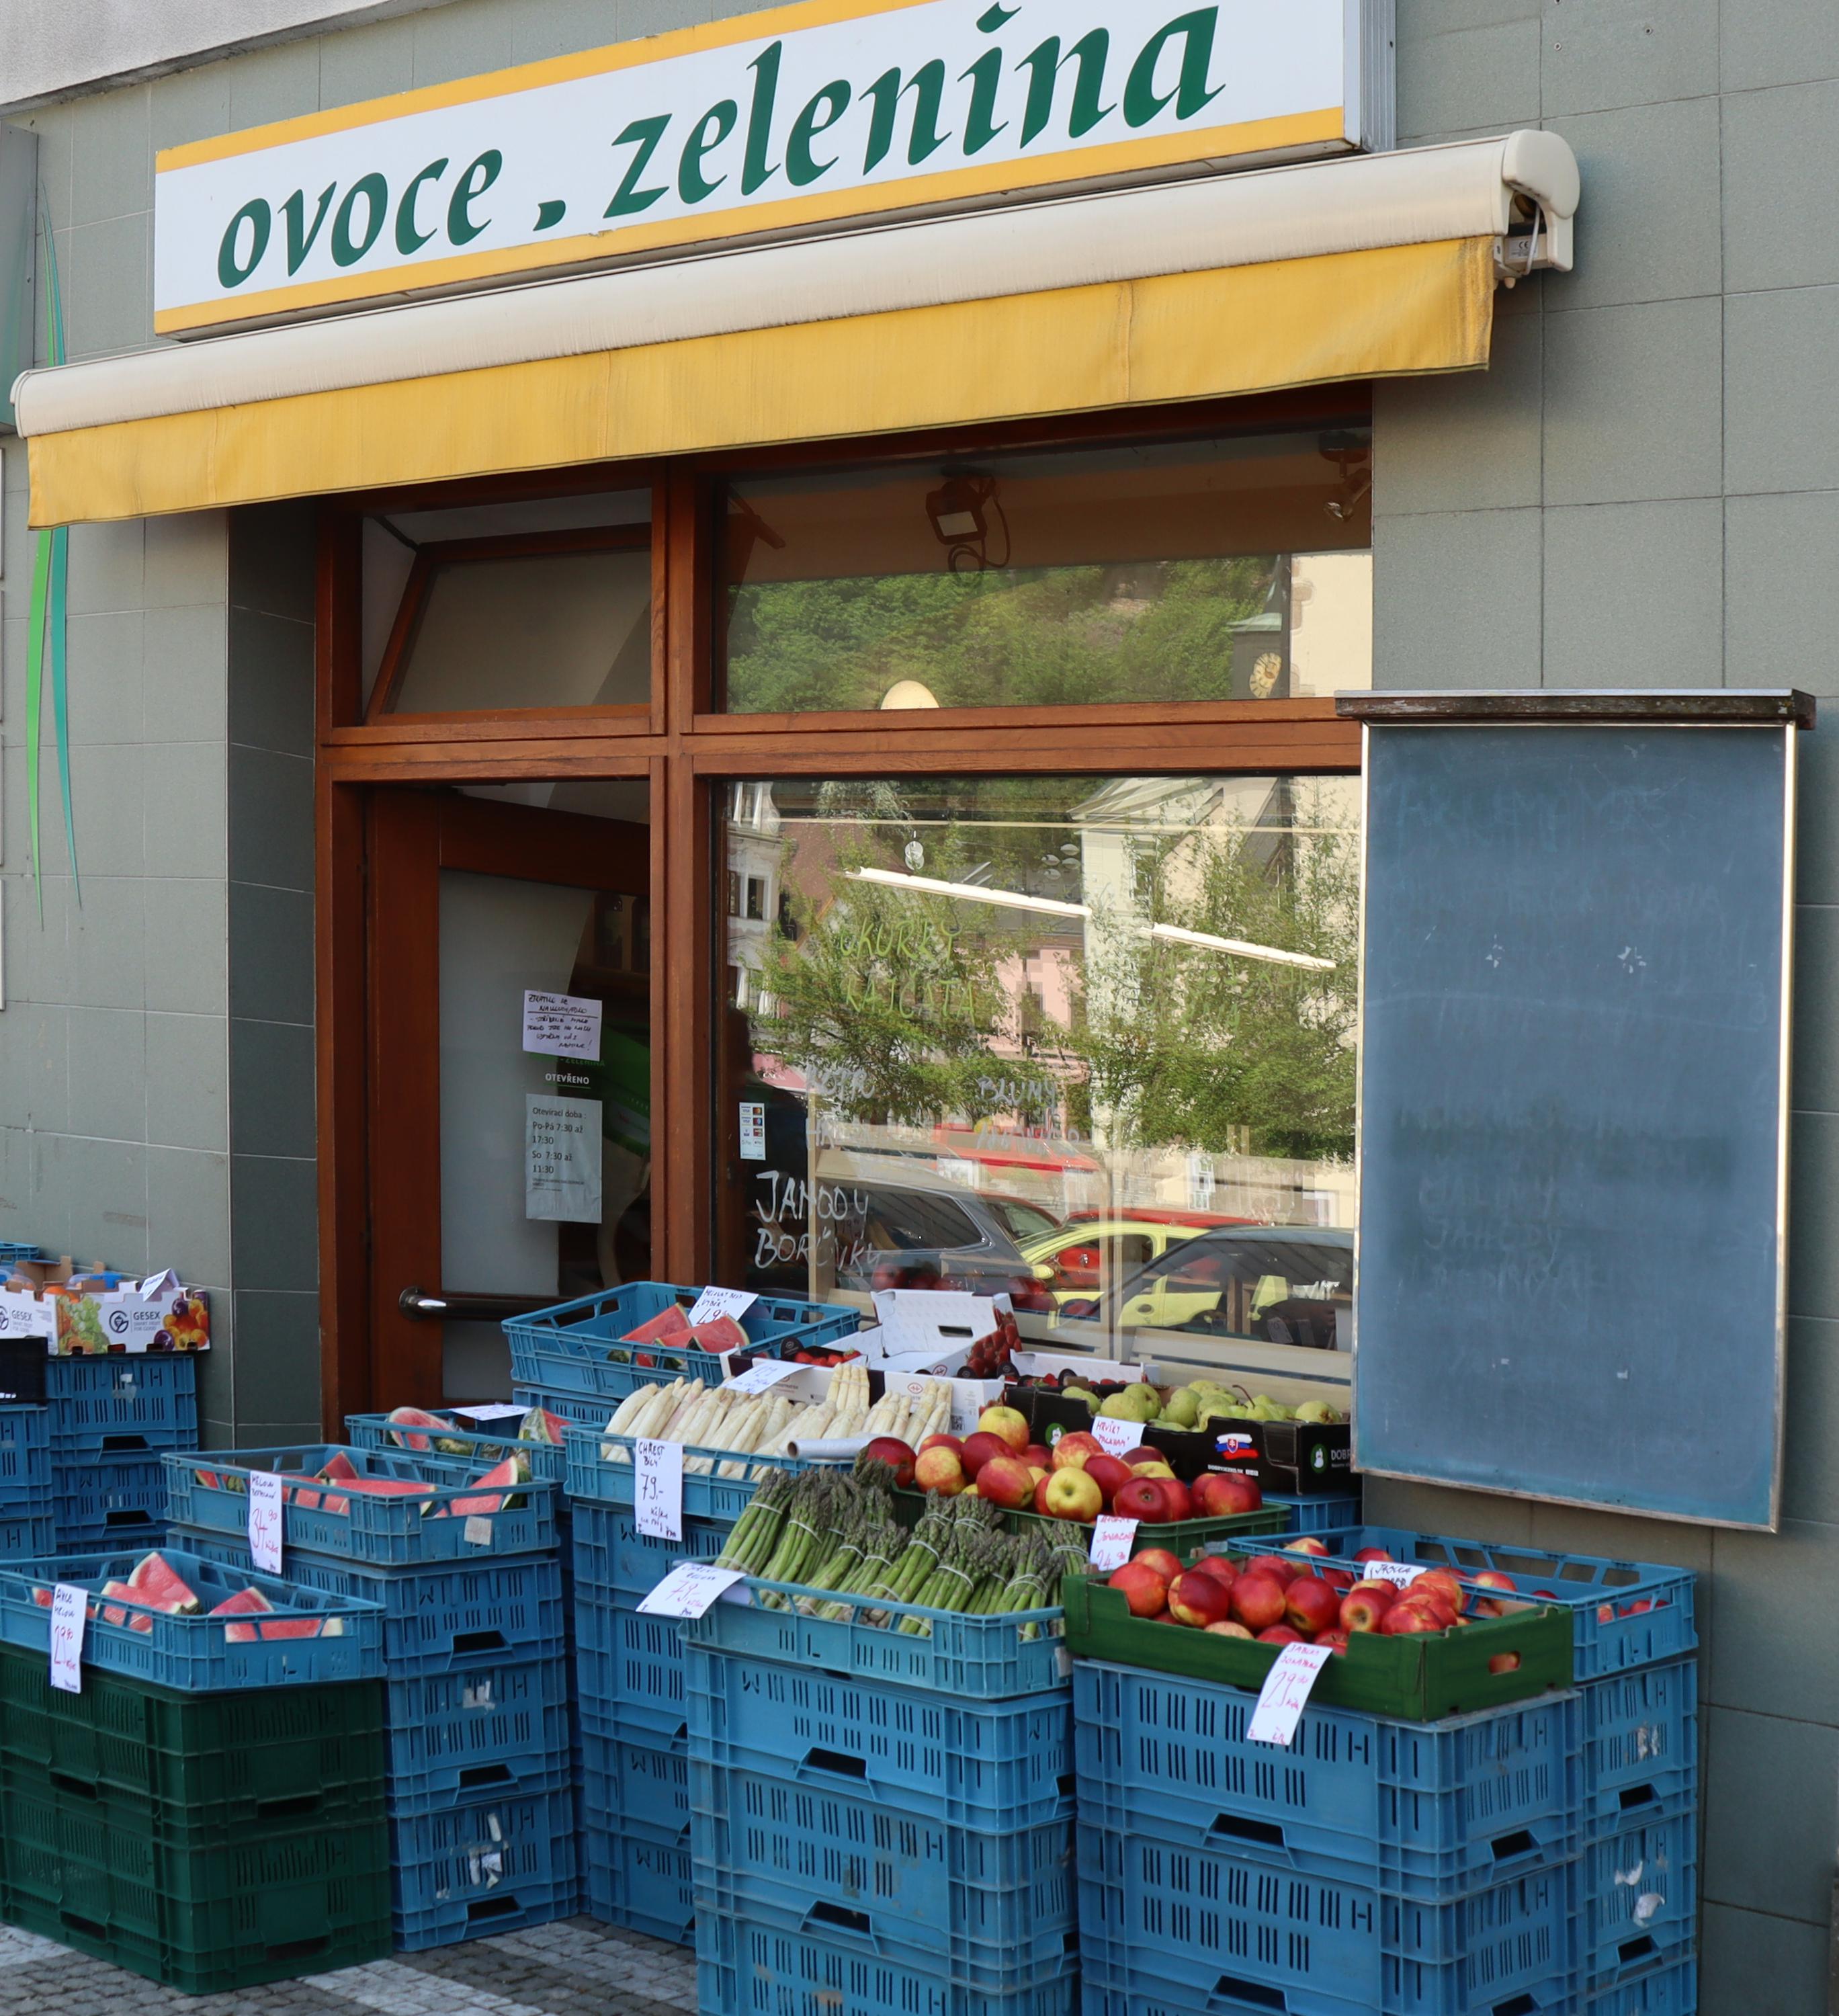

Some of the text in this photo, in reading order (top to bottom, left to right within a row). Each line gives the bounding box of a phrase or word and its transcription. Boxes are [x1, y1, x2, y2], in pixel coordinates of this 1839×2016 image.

[218, 149, 503, 288] ovoce
[603, 1, 1226, 218] zelenina
[545, 1073, 589, 1085] OTEVŘENO
[556, 1123, 572, 1132] 7:30
[532, 1136, 554, 1145] 17:30
[532, 1150, 542, 1159] So
[546, 1151, 562, 1161] 7:30
[533, 1165, 554, 1174] 11:30
[12, 1310, 32, 1322] GESEX
[133, 1311, 161, 1320] GESEX
